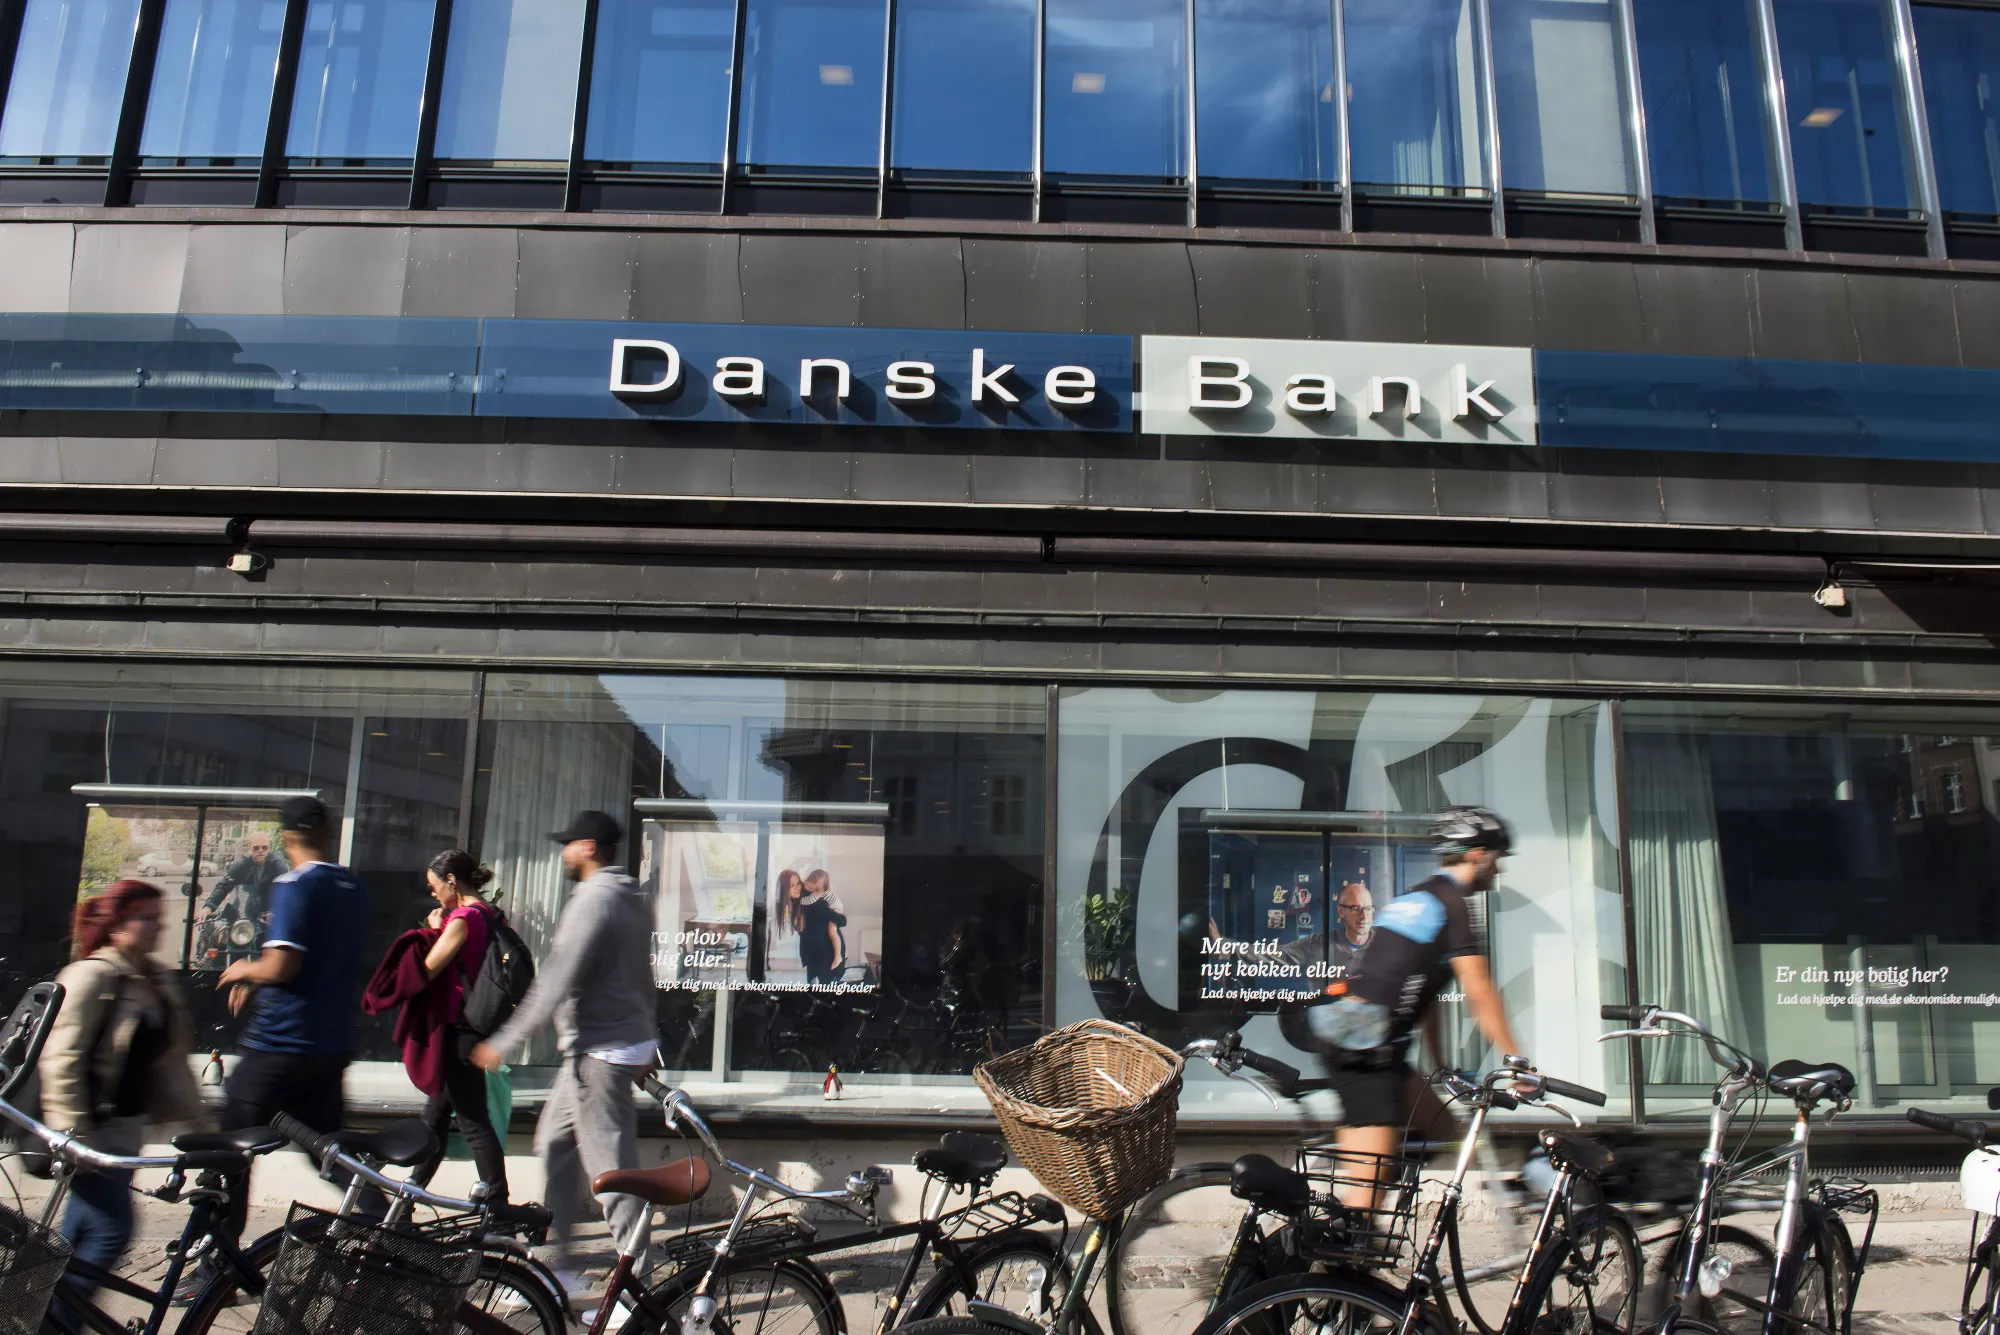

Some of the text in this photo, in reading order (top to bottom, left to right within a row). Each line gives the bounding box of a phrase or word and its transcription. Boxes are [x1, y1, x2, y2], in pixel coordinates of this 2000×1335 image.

[609, 338, 1503, 422] Danske Bank
[651, 928, 722, 946] ra orlov
[1200, 937, 1283, 957] Mere tid,
[649, 950, 735, 970] olig eller...
[1201, 962, 1232, 980] nyt
[1236, 960, 1301, 978] køkken
[1775, 966, 1949, 987] Er din nye bolig her?
[682, 979, 701, 992] dig
[702, 980, 726, 991] med
[728, 980, 742, 991] de
[744, 980, 810, 993] økonomiske
[812, 982, 876, 995] muligheder
[1201, 987, 1224, 999] Lad
[1226, 990, 1238, 999] os
[1240, 988, 1276, 1002] hjælpe
[1277, 988, 1296, 1001] dig
[1297, 989, 1320, 1000] med
[1777, 993, 1798, 1004] Lad
[1800, 996, 1812, 1004] os
[1813, 993, 1847, 1007] hjælpe
[1847, 993, 1865, 1007] dig
[1865, 993, 1887, 1004] med
[1888, 993, 1903, 1004] de
[1903, 993, 1963, 1005] økonomiske
